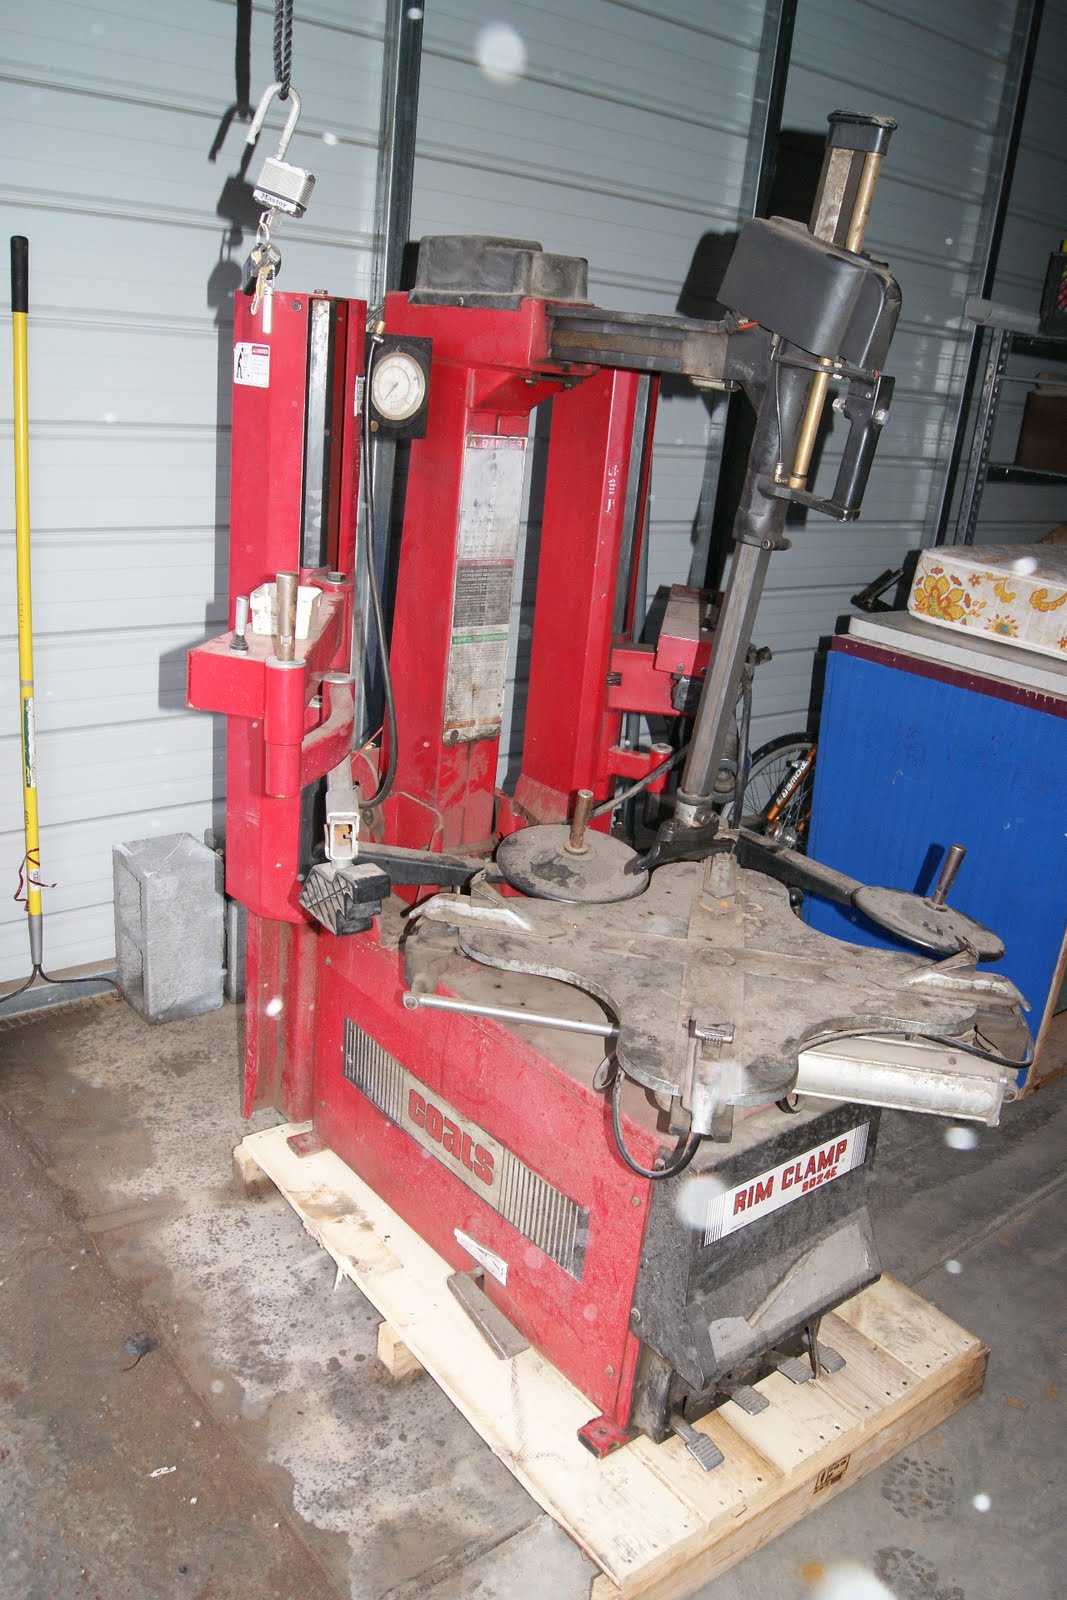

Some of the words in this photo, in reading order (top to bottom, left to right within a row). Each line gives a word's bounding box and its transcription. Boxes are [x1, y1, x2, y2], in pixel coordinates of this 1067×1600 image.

[260, 193, 288, 208] Master
[732, 1175, 774, 1216] RIM
[781, 1138, 848, 1190] CLAMP
